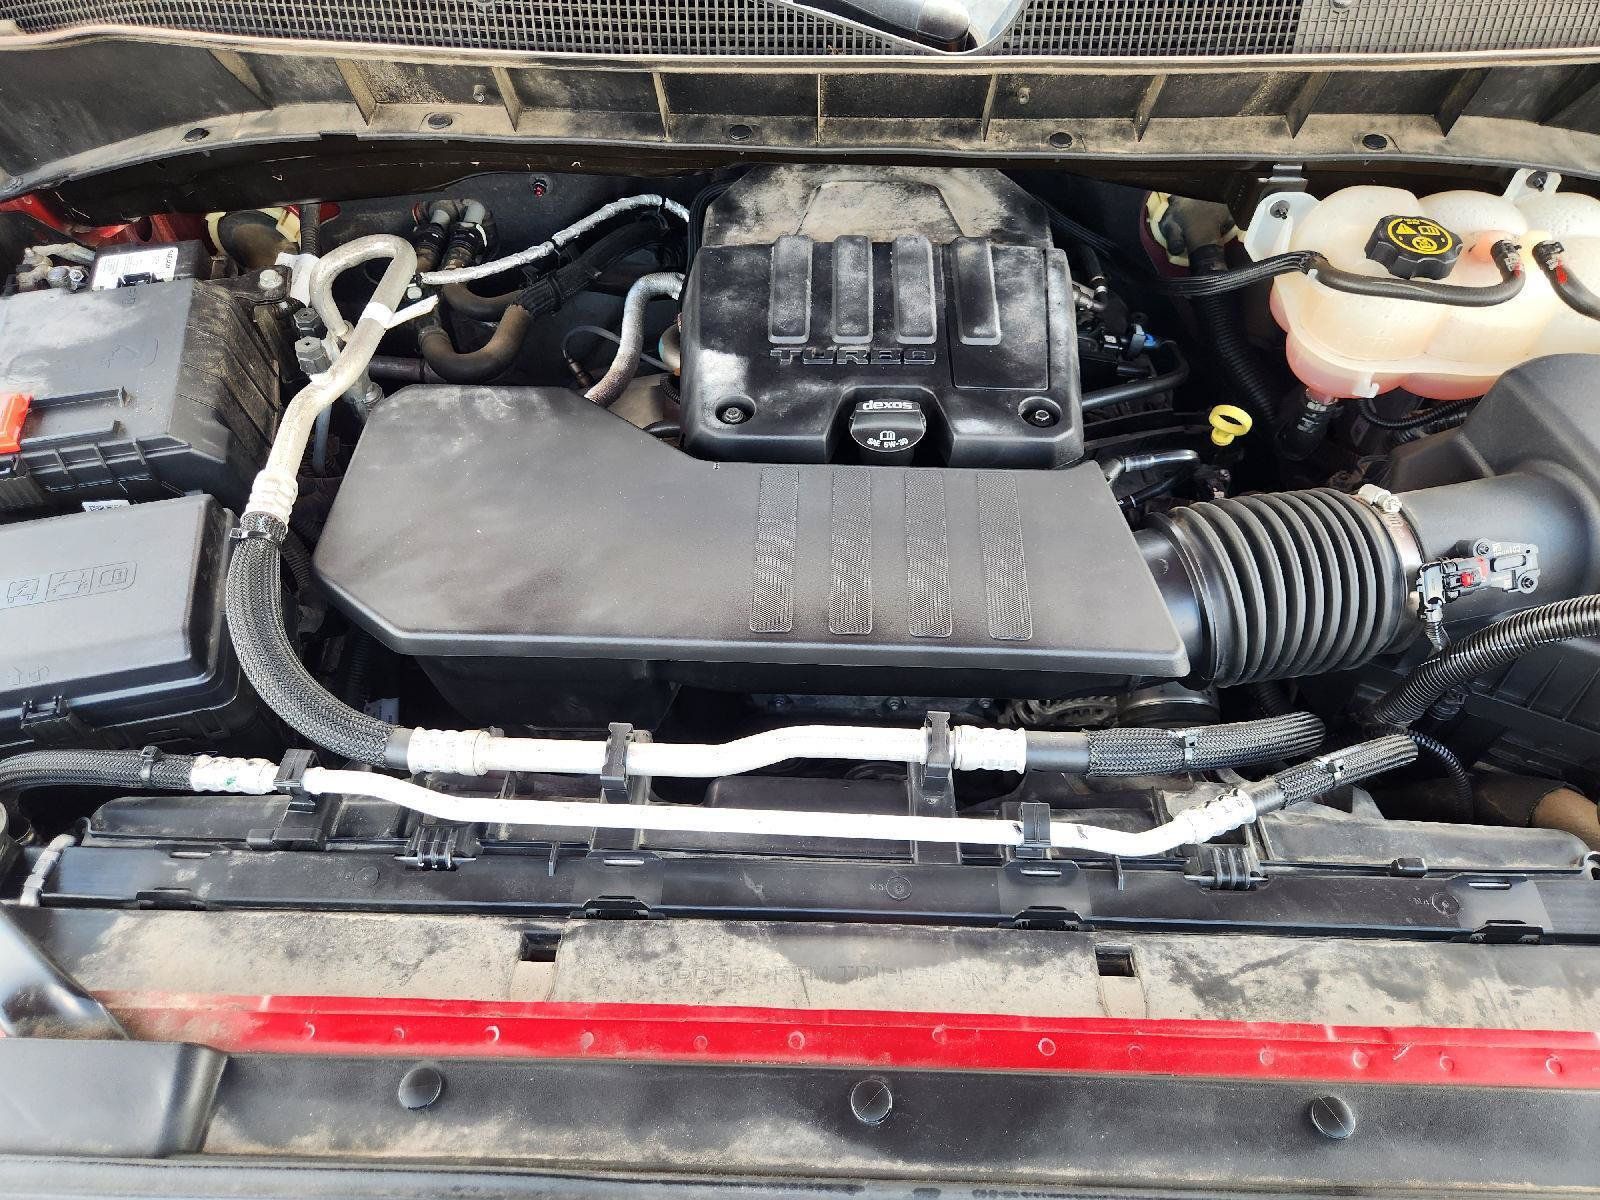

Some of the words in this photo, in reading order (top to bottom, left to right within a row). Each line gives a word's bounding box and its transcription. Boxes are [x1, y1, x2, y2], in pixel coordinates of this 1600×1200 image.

[770, 347, 937, 365] TURBO
[862, 400, 914, 410] dexos
[866, 437, 882, 448] SAE
